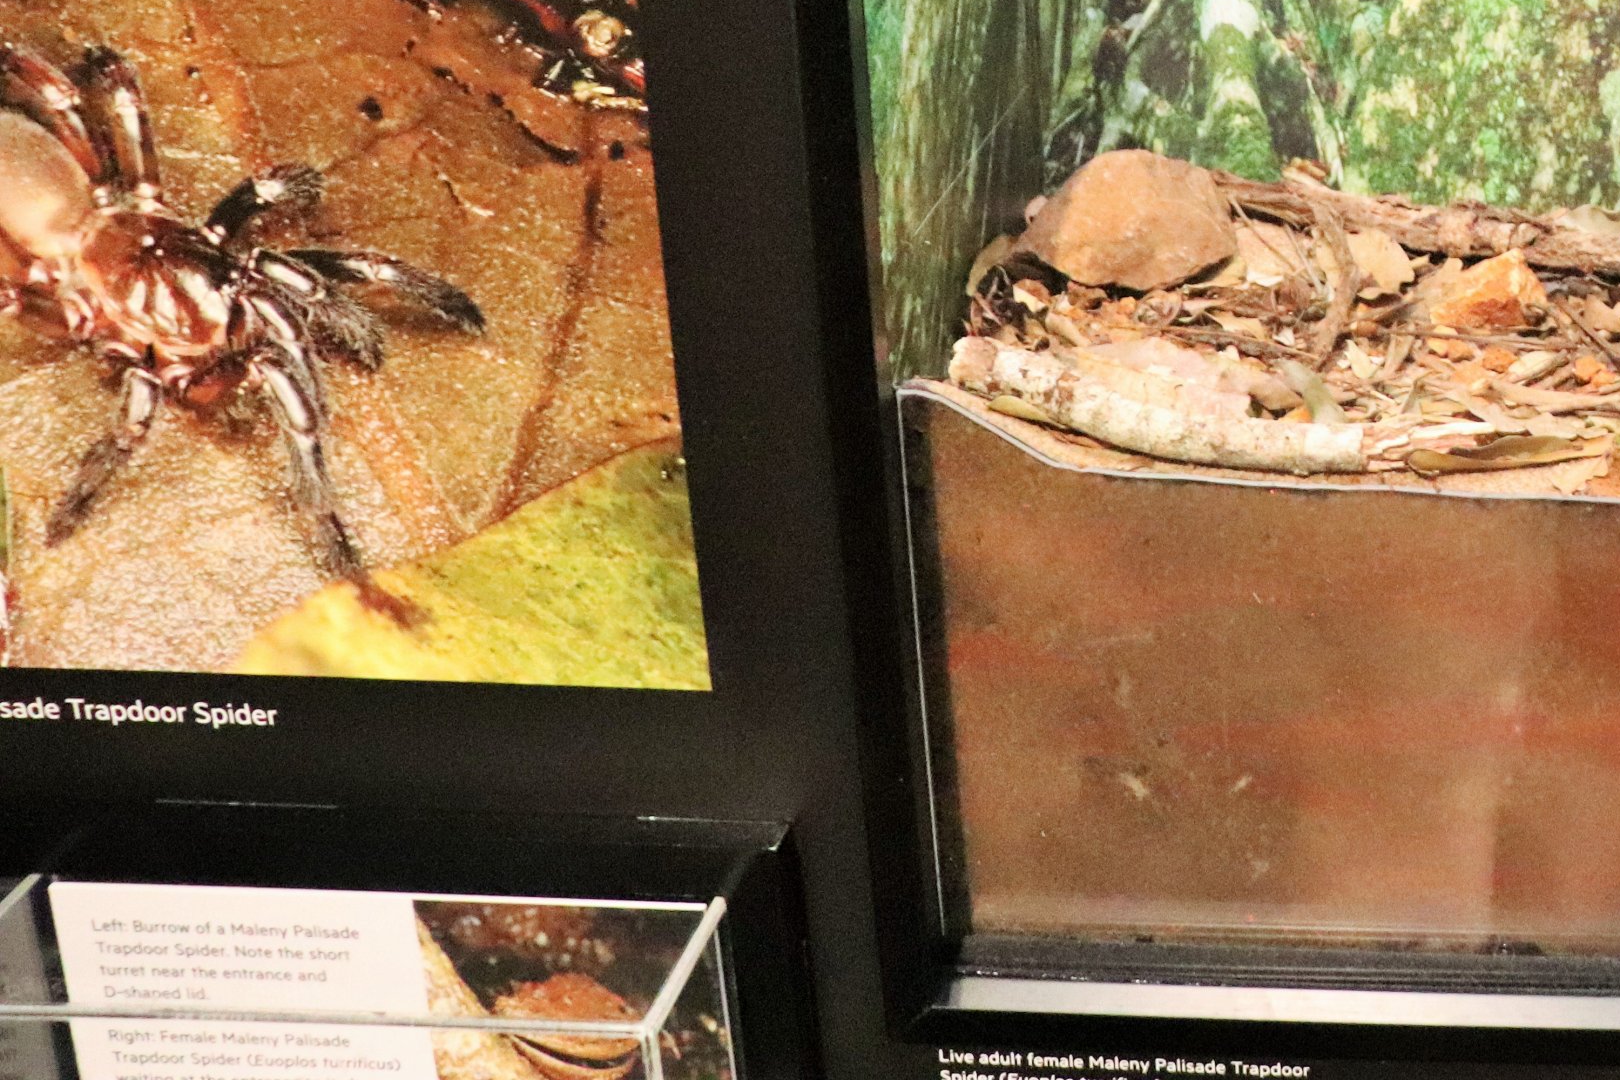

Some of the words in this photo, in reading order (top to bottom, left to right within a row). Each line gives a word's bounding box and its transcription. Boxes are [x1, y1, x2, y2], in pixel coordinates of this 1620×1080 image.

[64, 698, 187, 726] Trapdoor
[192, 701, 278, 729] Spider
[91, 918, 127, 932] Left:
[132, 919, 190, 934] Burrow
[195, 921, 211, 935] of
[216, 925, 226, 936] a
[230, 923, 288, 940] Maleny
[292, 924, 360, 940] Palisade
[95, 940, 169, 957] Trapdoor
[233, 945, 273, 959] Note
[277, 946, 304, 960] the
[308, 948, 350, 962] short
[99, 964, 146, 977] turret
[150, 967, 186, 979] near
[191, 967, 218, 979] the
[222, 968, 292, 981] entrance
[297, 970, 328, 983] and
[159, 1029, 216, 1044] Female
[221, 1032, 279, 1047] Maleny
[284, 1033, 350, 1048] Palisade
[111, 1050, 185, 1066] Trapdoor
[190, 1052, 241, 1067] Spider
[246, 1053, 318, 1070] (Euoplos
[322, 1057, 402, 1072] turrificus)
[938, 1048, 975, 1065] Live
[978, 1051, 1022, 1066] adult
[1026, 1052, 1084, 1069] female
[1088, 1055, 1150, 1074] Maleny
[1154, 1057, 1226, 1075] Palisade
[1230, 1060, 1310, 1078] Trapdoor
